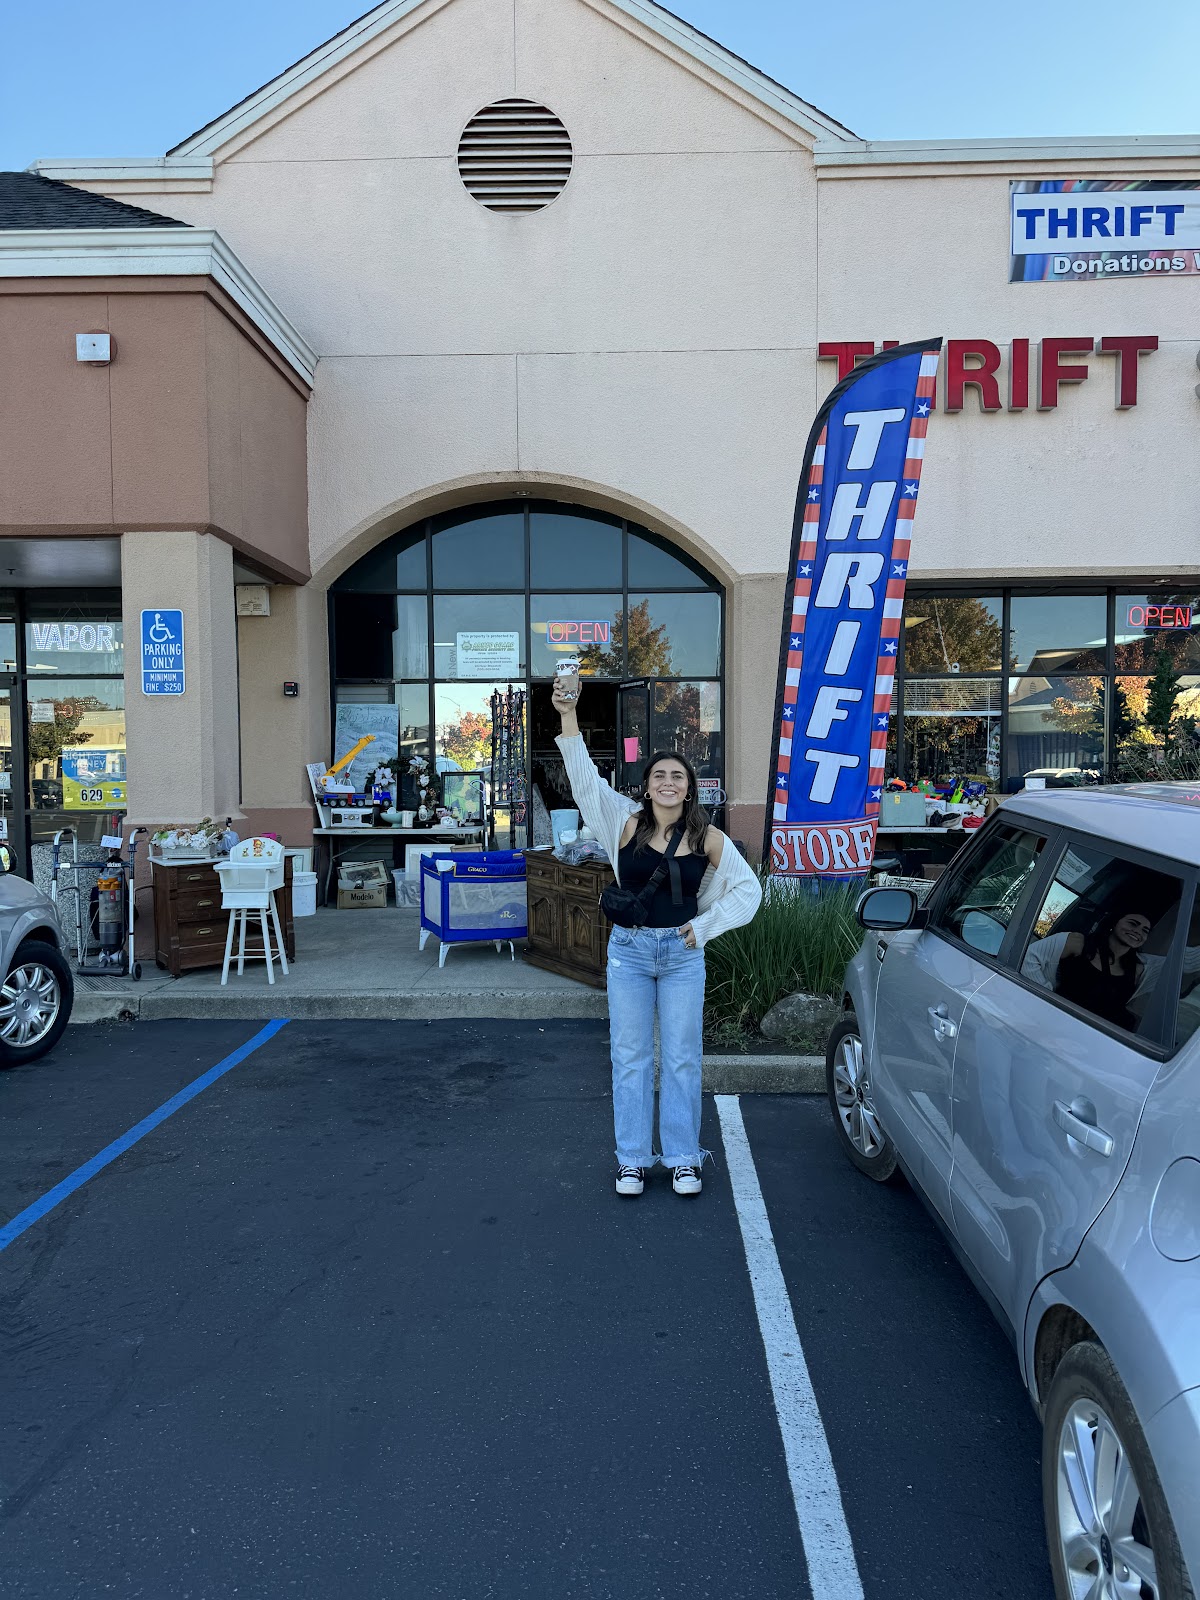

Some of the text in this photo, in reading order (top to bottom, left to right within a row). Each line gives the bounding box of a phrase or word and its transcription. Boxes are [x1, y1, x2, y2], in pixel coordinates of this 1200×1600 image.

[1016, 205, 1185, 240] THRIFT
[1052, 254, 1186, 275] Donations
[818, 336, 1159, 413] TRIFT
[805, 407, 906, 805] THRIFT
[1128, 605, 1191, 628] OPEN
[32, 623, 115, 651] VAPOR
[549, 622, 608, 642] OPEN
[144, 643, 182, 656] PARKING
[151, 656, 175, 669] ONLY
[146, 682, 182, 692] FINE $250
[150, 673, 177, 682] MINIMUM
[771, 824, 878, 874] STORE
[350, 892, 374, 901] Modelo
